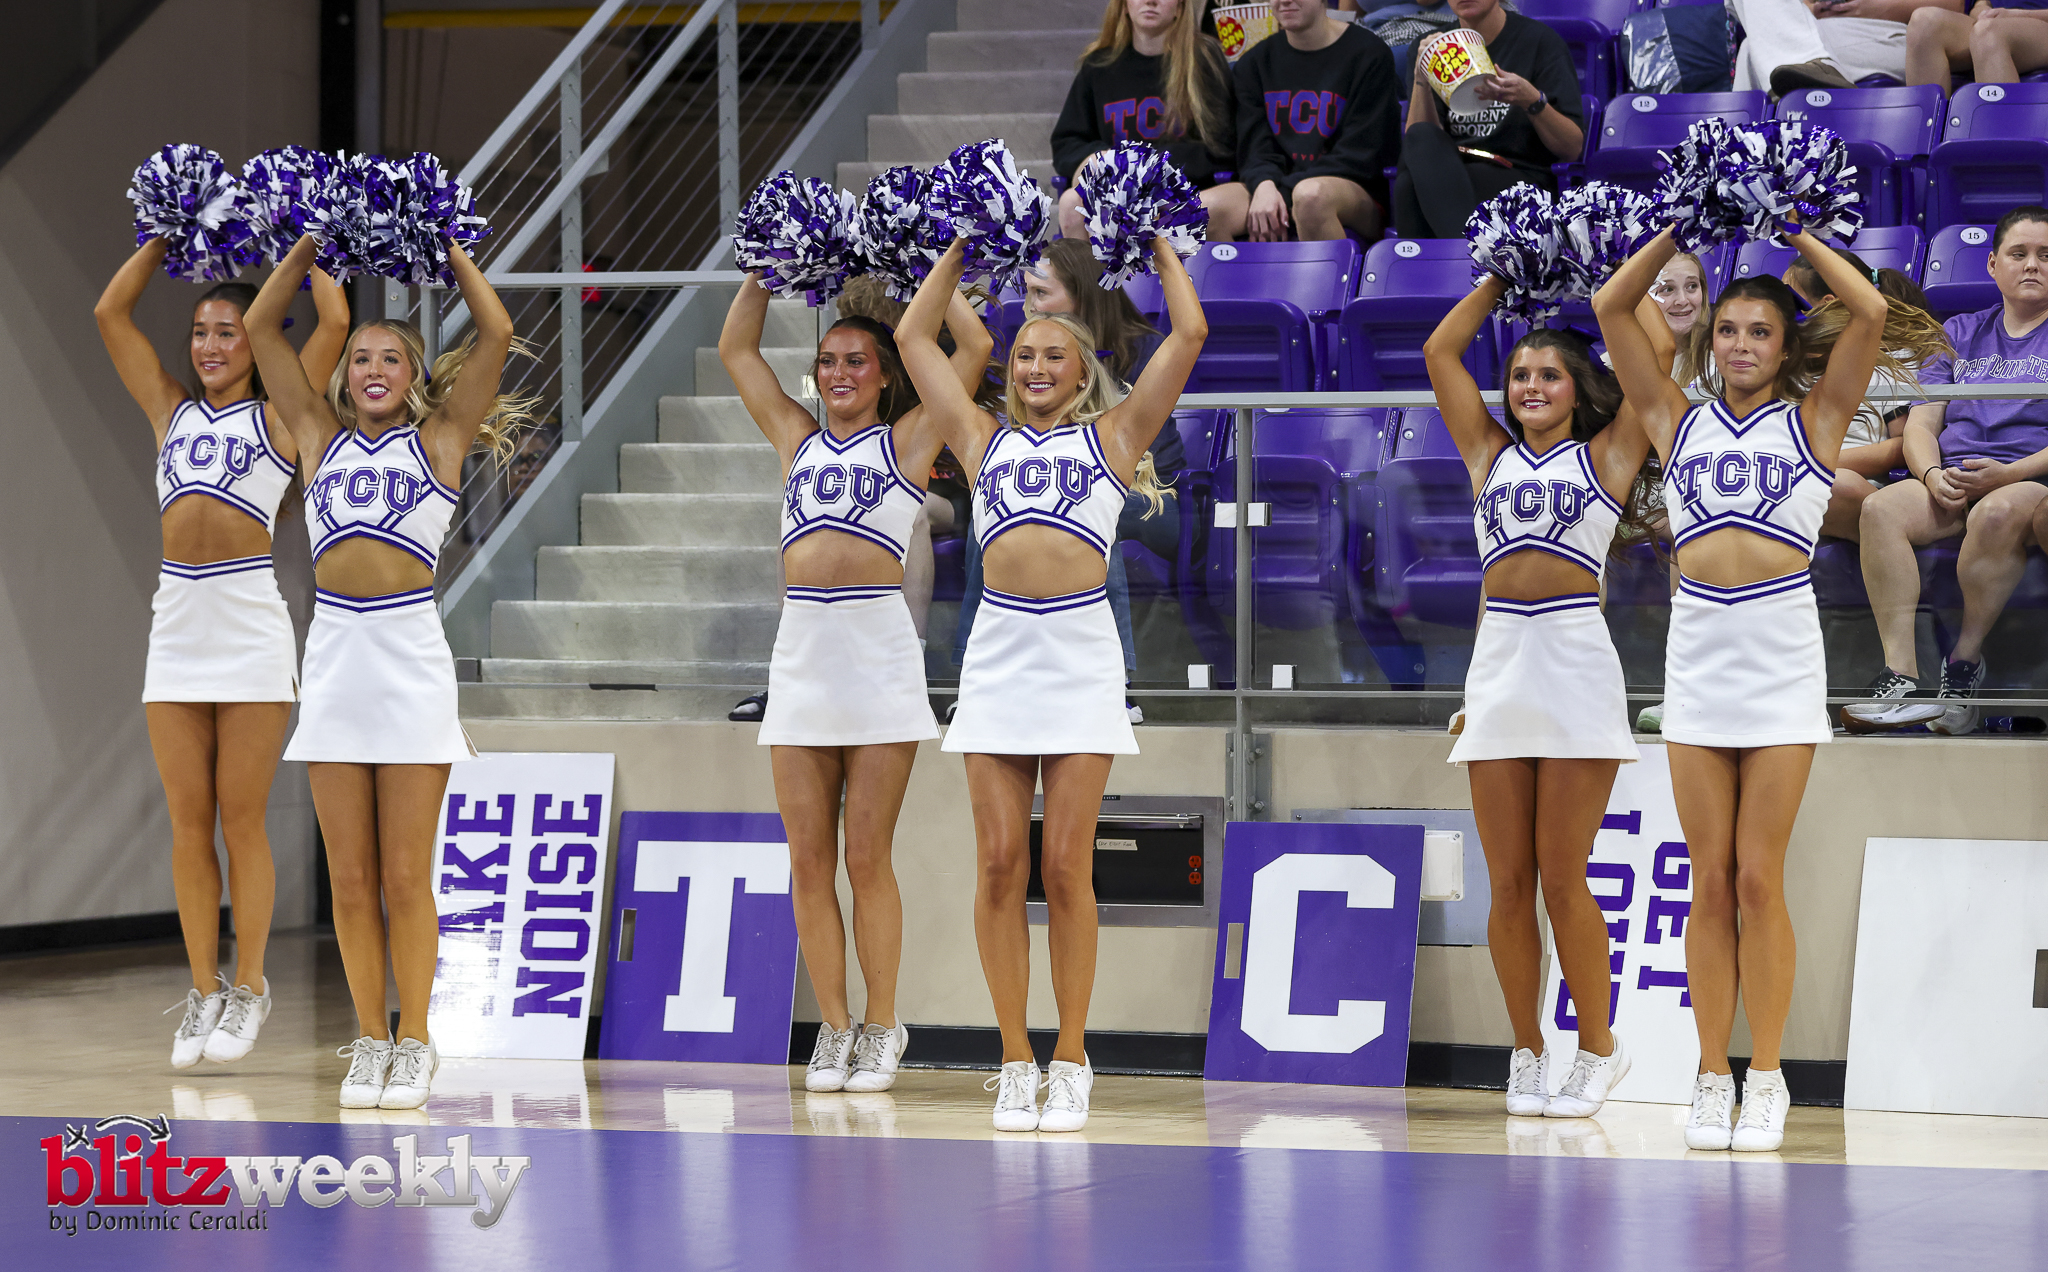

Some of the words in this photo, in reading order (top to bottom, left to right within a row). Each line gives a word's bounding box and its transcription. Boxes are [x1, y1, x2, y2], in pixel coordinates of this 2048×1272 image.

[1222, 29, 1245, 52] ORN
[1434, 46, 1458, 72] POP
[1440, 50, 1470, 83] CORN
[1264, 90, 1346, 138] TCU
[1986, 89, 1997, 97] 14
[1103, 96, 1187, 146] TC
[1402, 245, 1413, 253] 12
[1967, 232, 1980, 240] 15
[162, 432, 258, 481] TCU
[1675, 451, 1798, 509] TCU
[314, 467, 423, 522] TCU
[785, 464, 889, 519] TCU
[980, 456, 1095, 515] TCU
[1480, 479, 1589, 538] TCU
[433, 794, 516, 1017] AKE
[512, 794, 602, 1018] NOISE
[633, 840, 791, 1033] T
[1240, 852, 1396, 1054] C
